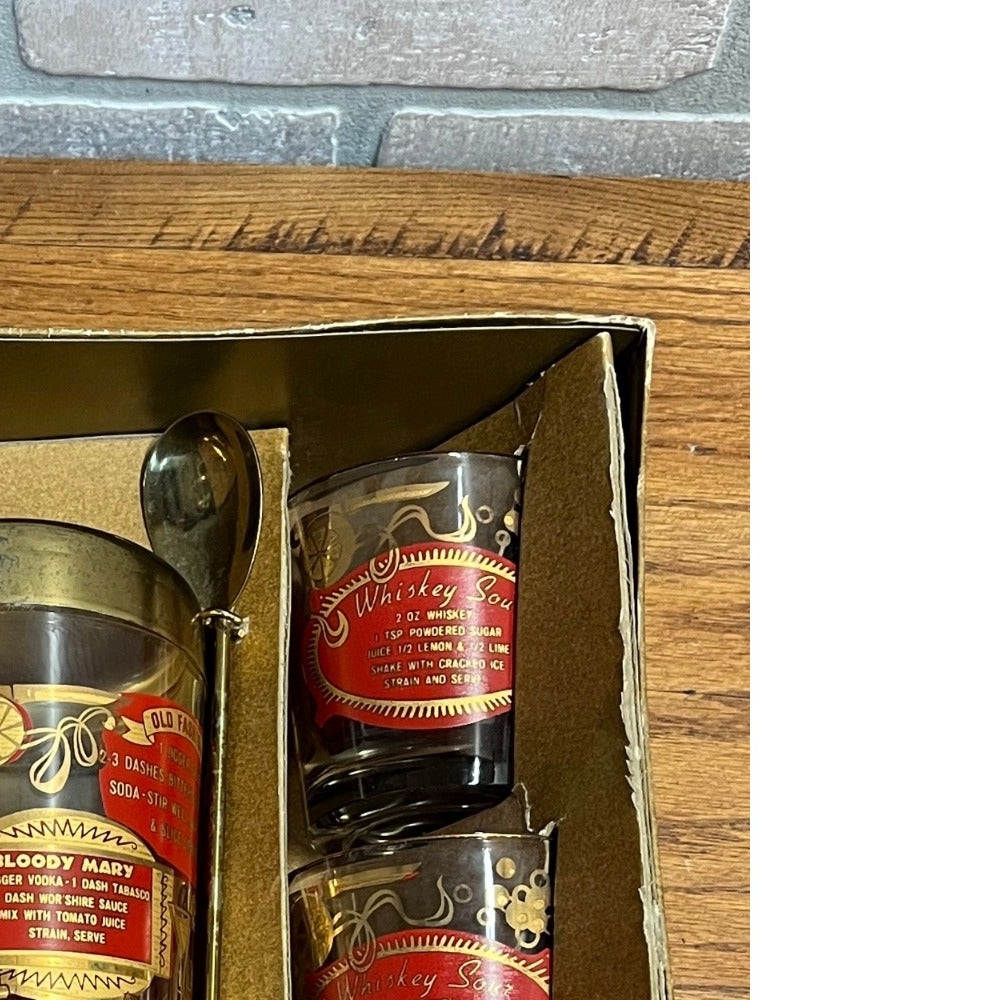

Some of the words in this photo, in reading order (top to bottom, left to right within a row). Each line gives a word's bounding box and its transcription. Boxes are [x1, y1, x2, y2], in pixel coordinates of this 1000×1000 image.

[355, 570, 457, 618] Whiskey
[396, 613, 401, 623] 2
[407, 611, 420, 621] OZ
[427, 609, 473, 620] WHISKEY
[386, 630, 402, 640] TSP
[410, 626, 465, 637] POWDERED
[471, 627, 502, 636] SUGAR
[398, 644, 412, 653] 1/2
[418, 642, 452, 652] LEMON
[457, 642, 464, 652] &
[489, 644, 510, 654] LIME
[372, 663, 402, 674] SHAKE
[408, 660, 433, 671] WITH
[490, 660, 504, 671] ICE
[385, 677, 419, 688] STRAIN
[426, 674, 446, 684] AND
[151, 711, 173, 729] OLD
[100, 750, 119, 766] 2-3
[125, 756, 164, 782] DASHES
[151, 819, 156, 831] &
[82, 858, 133, 878] MARY
[82, 879, 108, 892] DASH
[112, 883, 150, 901] TABASCO
[5, 893, 34, 903] DASH
[99, 900, 128, 913] SAUCE
[0, 910, 18, 919] MIX
[24, 910, 50, 921] WITH
[56, 911, 97, 925] TOMATO
[102, 918, 126, 929] JUICE
[29, 928, 70, 941] STRAIN,
[74, 930, 105, 944] SERVE
